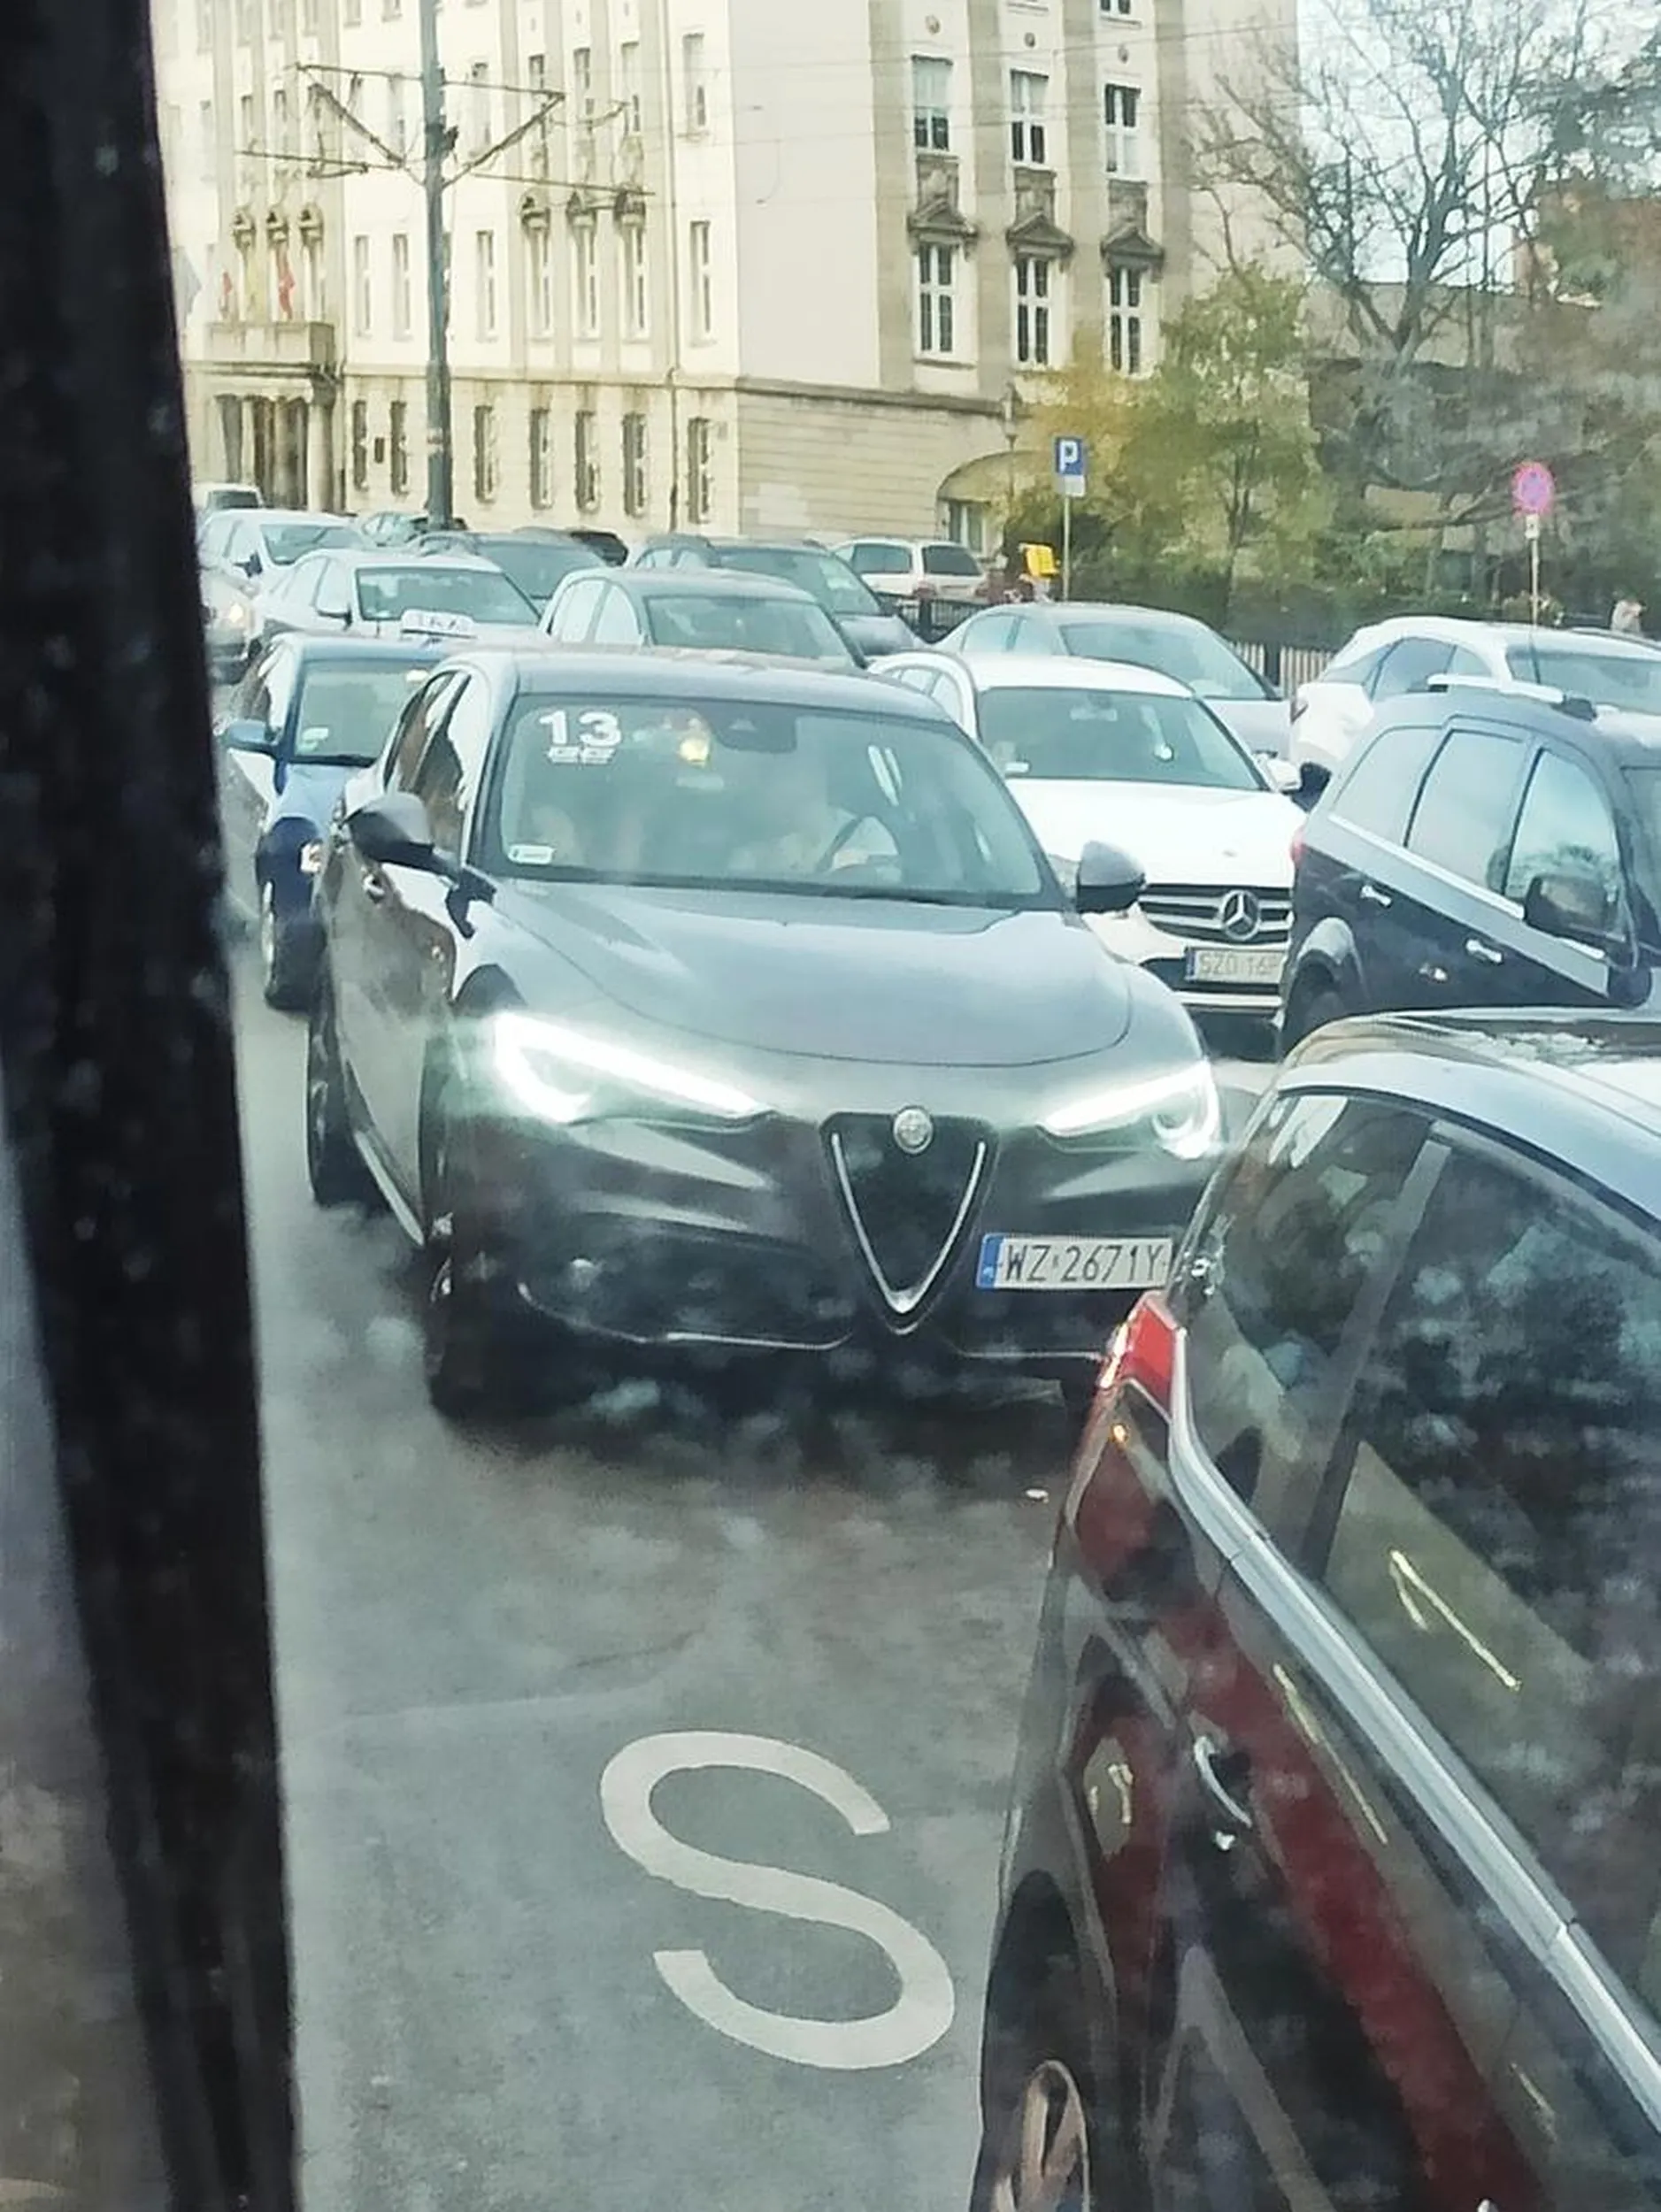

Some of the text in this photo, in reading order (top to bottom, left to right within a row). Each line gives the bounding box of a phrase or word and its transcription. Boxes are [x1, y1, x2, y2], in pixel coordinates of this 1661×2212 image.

[1058, 440, 1078, 472] P
[539, 710, 621, 746] 13
[1005, 1244, 1165, 1282] WZ 2671Y
[600, 1730, 956, 2070] S
